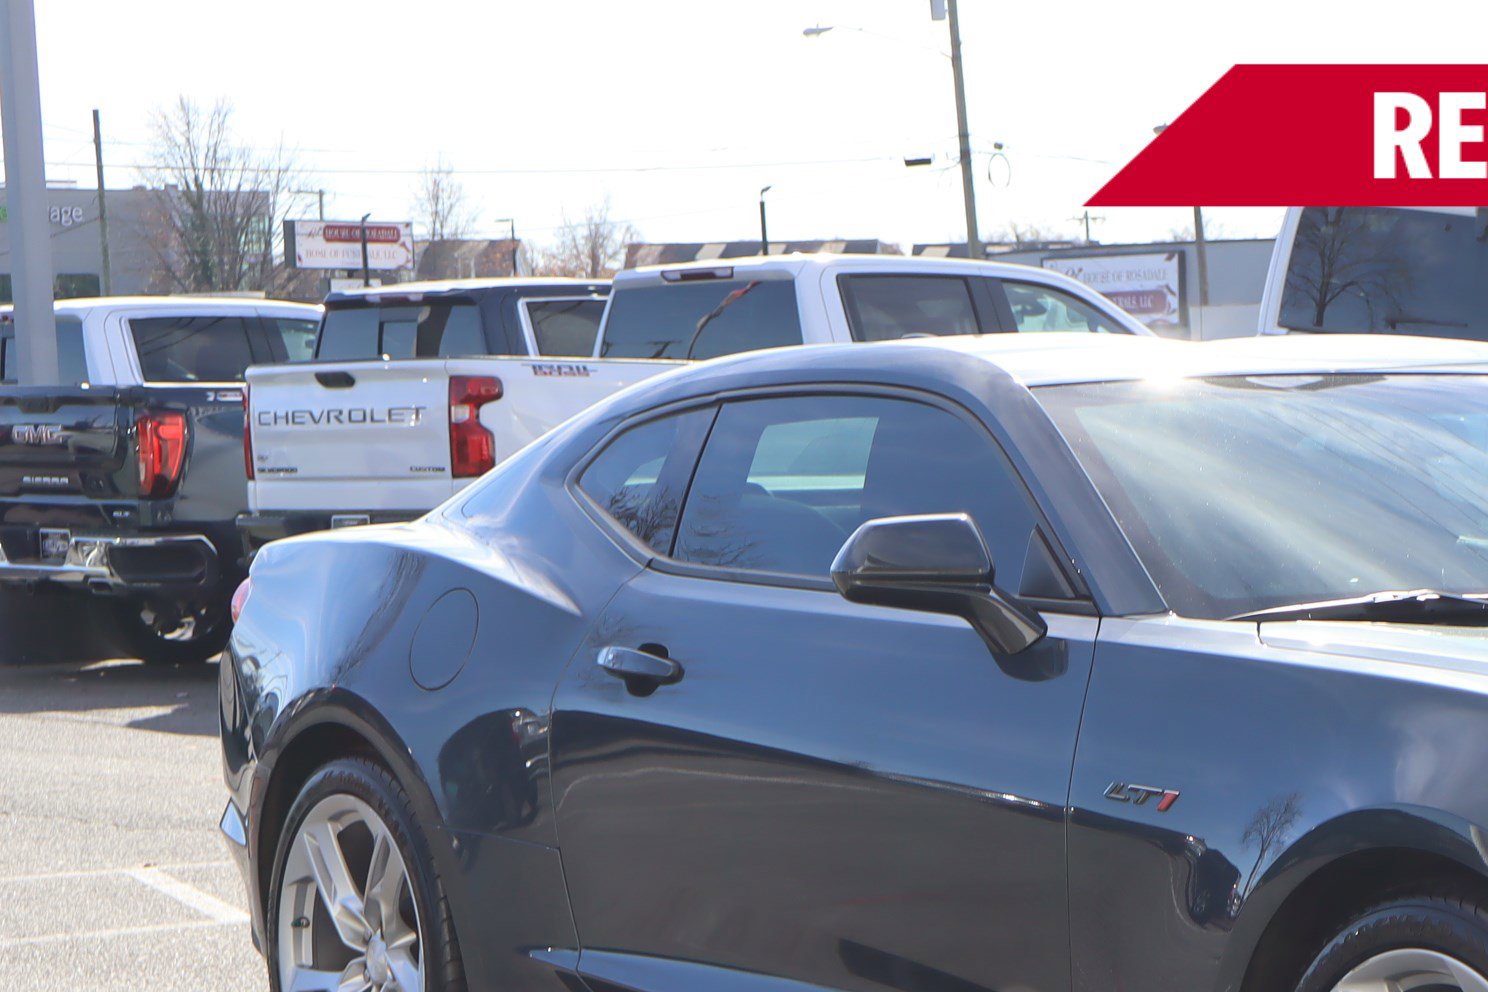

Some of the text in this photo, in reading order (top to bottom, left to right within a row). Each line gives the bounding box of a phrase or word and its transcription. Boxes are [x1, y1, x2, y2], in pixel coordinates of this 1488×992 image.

[258, 406, 427, 427] CHEVROLET
[12, 424, 62, 445] GMC
[409, 465, 446, 473] CUSTOM
[22, 475, 69, 485] SIERRA
[1103, 782, 1180, 812] LT1
